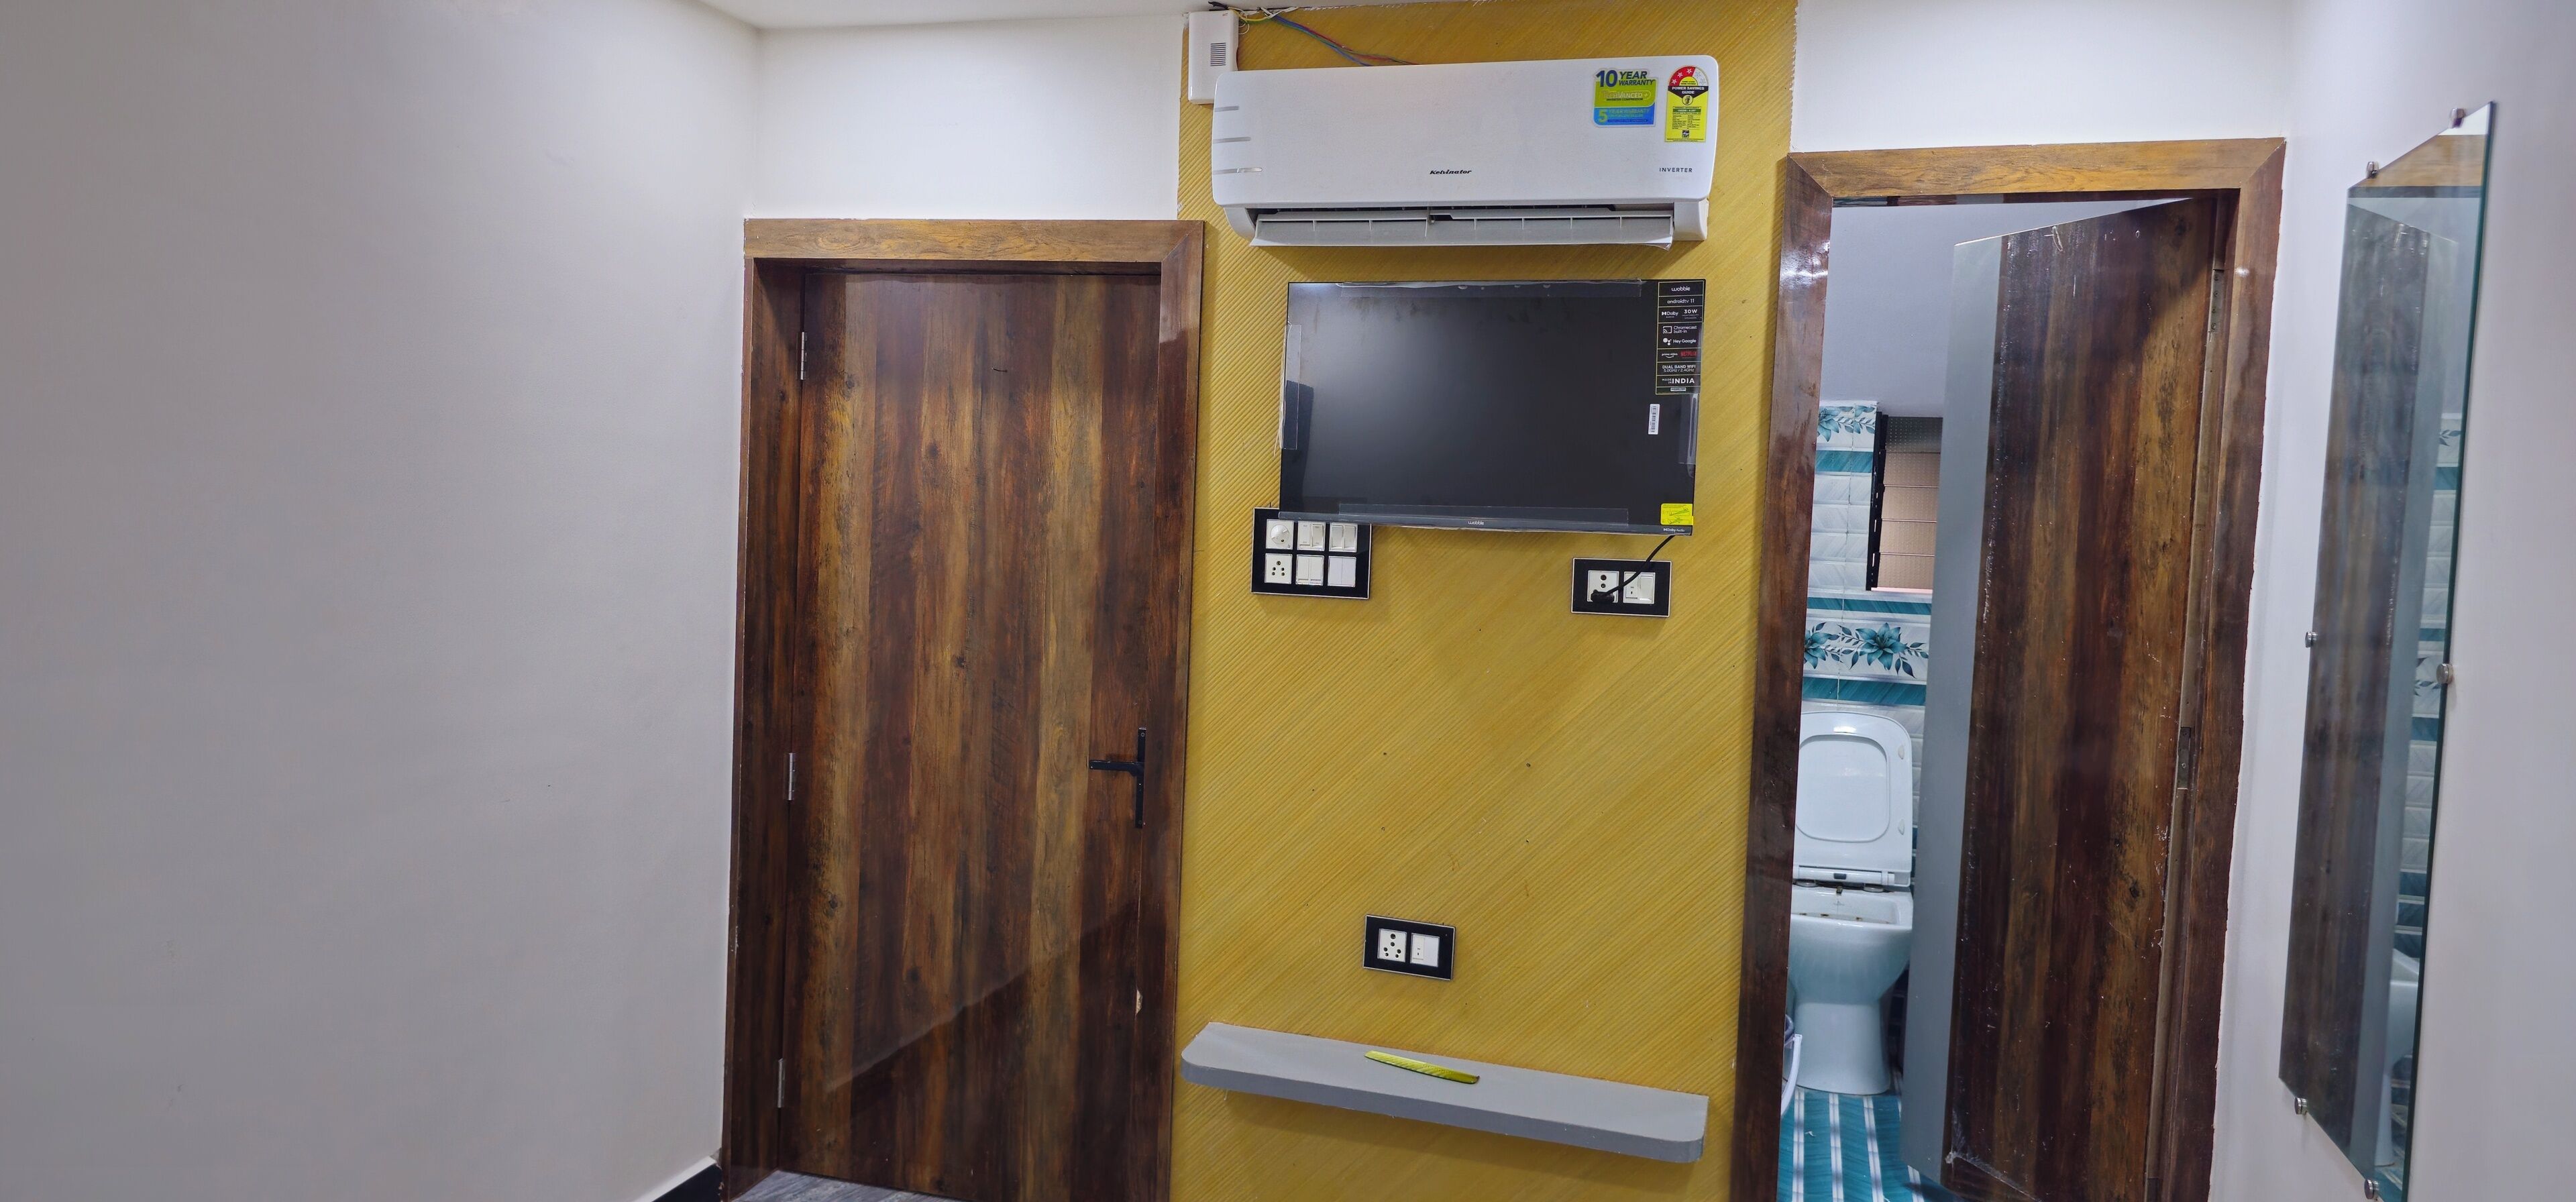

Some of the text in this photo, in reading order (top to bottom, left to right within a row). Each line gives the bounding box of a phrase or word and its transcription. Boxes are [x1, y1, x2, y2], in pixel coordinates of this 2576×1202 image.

[1596, 70, 1618, 87] 10
[1619, 71, 1648, 79] YEAR
[1599, 109, 1608, 123] 5
